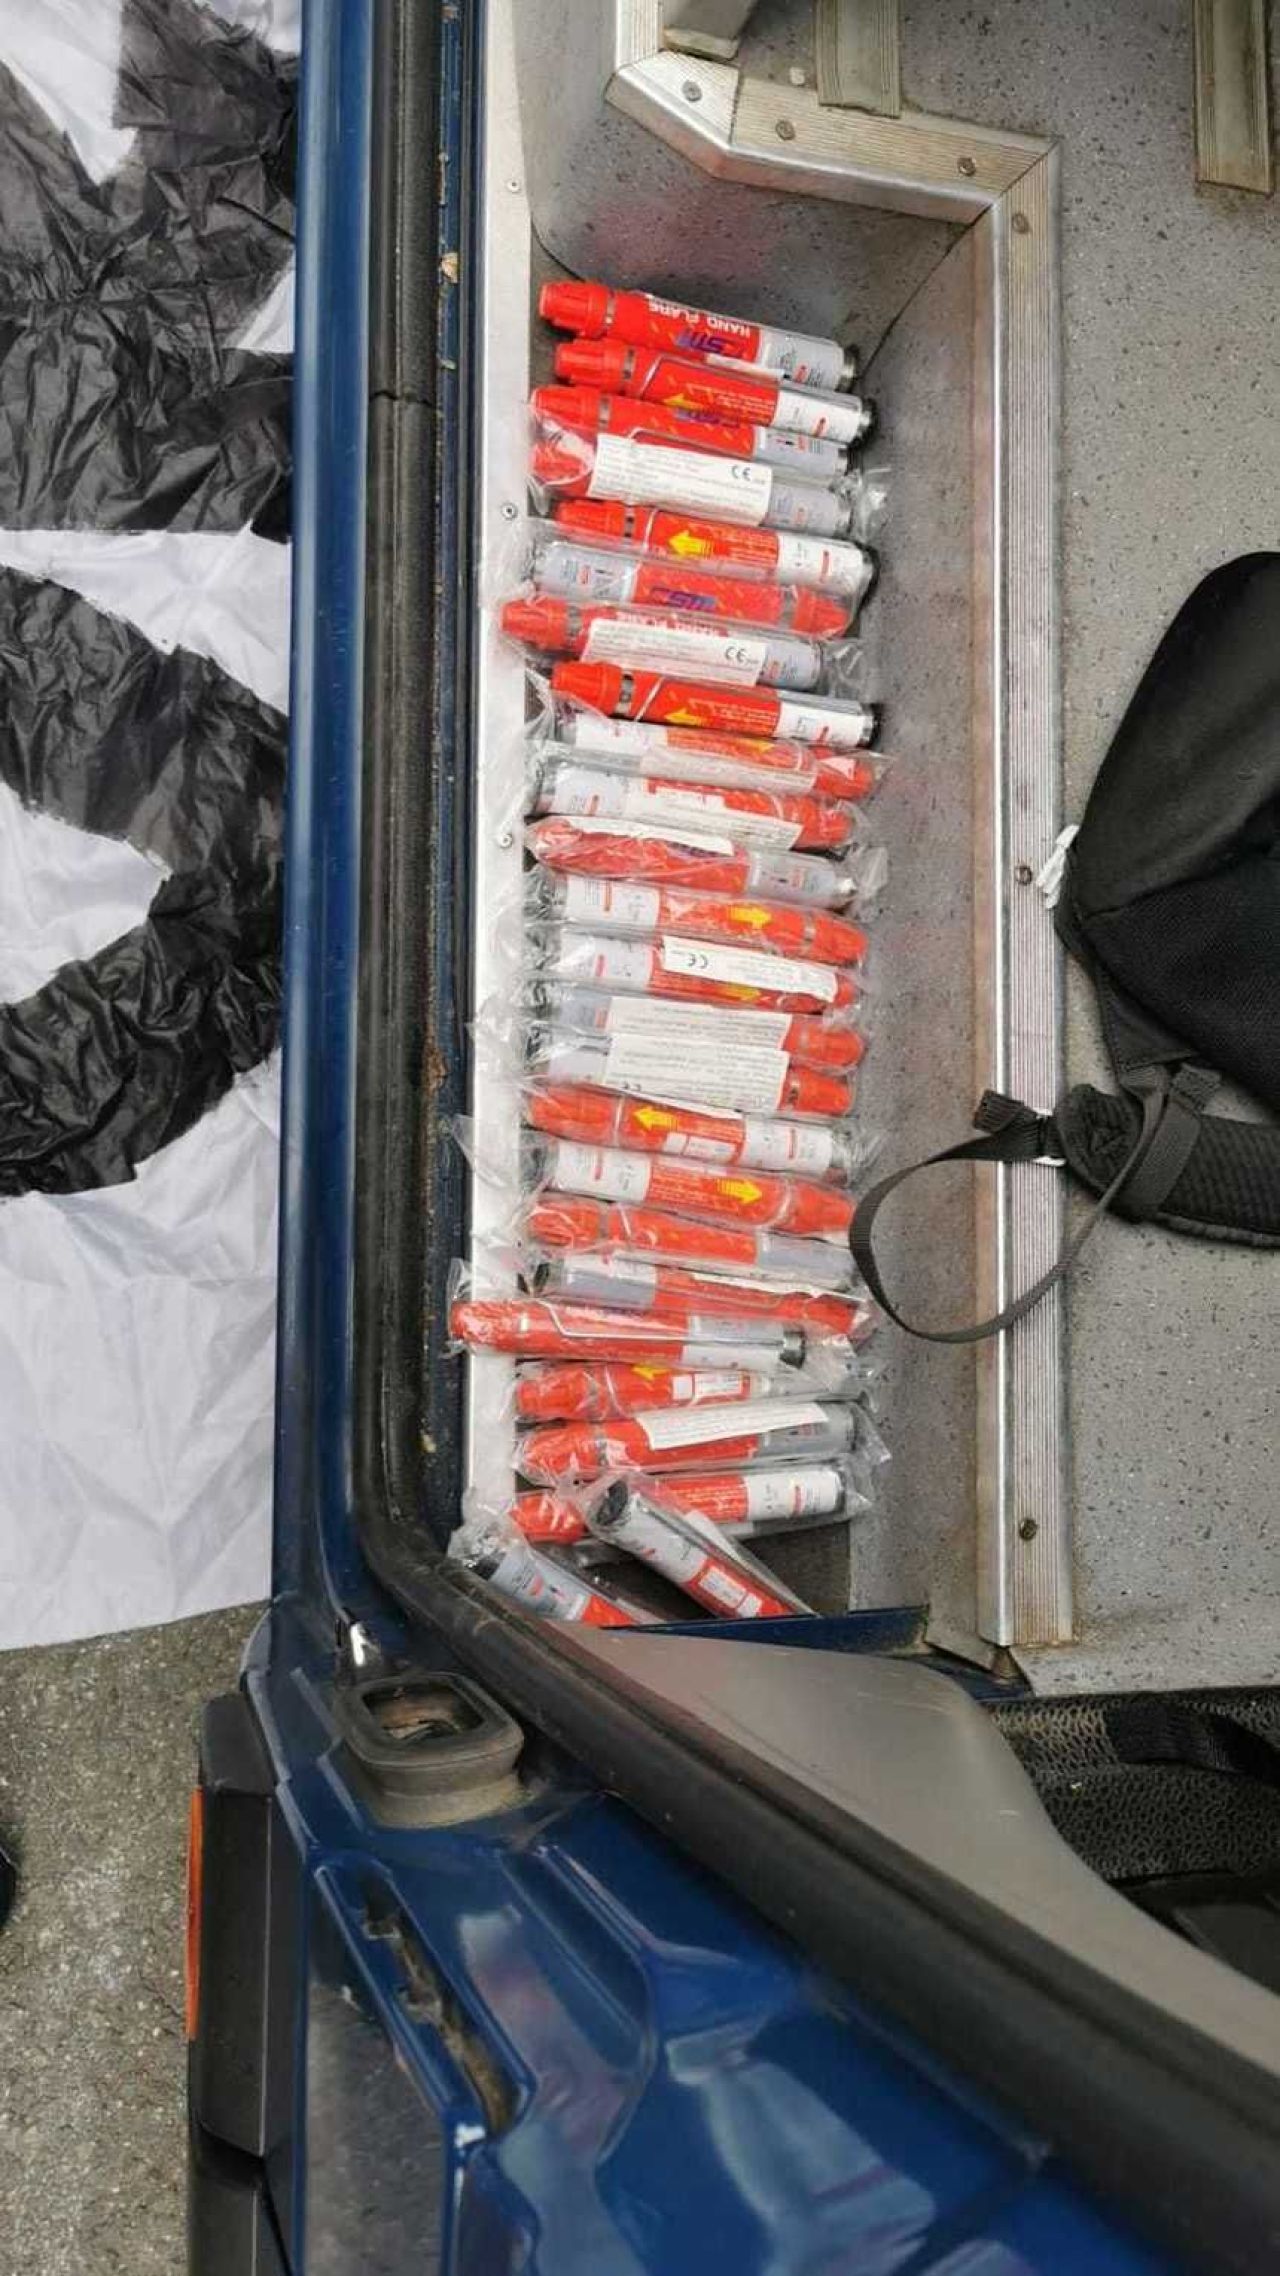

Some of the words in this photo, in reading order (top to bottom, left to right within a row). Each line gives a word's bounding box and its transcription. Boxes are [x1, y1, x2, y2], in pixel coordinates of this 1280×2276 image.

[648, 301, 699, 324] FLARE
[706, 316, 751, 338] HAND
[731, 465, 751, 481] CE
[725, 646, 746, 662] CE
[688, 952, 708, 969] CE
